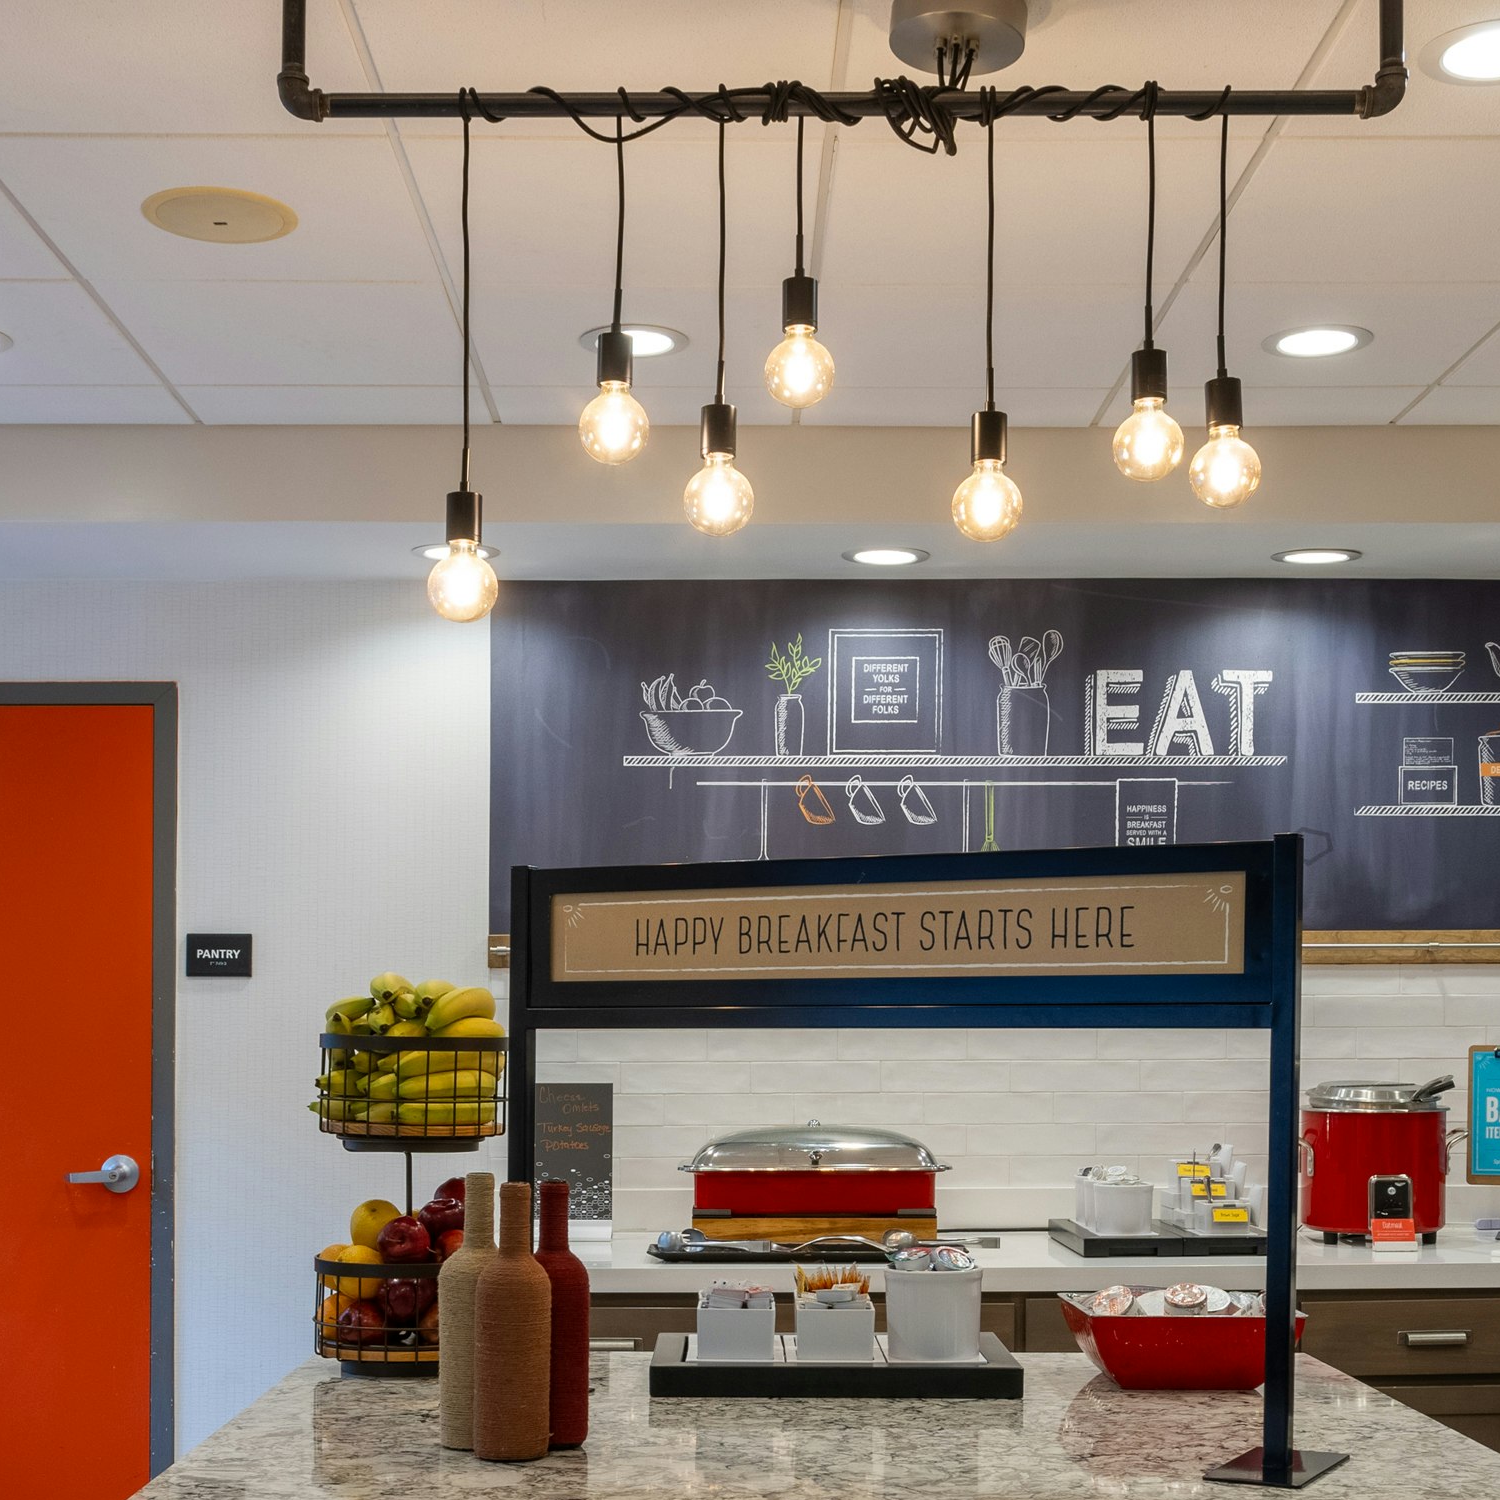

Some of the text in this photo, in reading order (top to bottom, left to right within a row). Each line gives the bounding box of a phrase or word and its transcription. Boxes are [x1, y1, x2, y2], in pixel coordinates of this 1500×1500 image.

[863, 663, 909, 673] DIFFERENT
[872, 674, 900, 683] YOLKS
[863, 694, 908, 704] DIFFERENT
[872, 705, 899, 714] FOLKS
[1086, 669, 1273, 757] EAT
[1407, 780, 1448, 791] RECIPES
[1126, 804, 1167, 813] HAPPINESS
[1126, 820, 1167, 829] BREAKFAST
[635, 906, 1136, 957] HAPPY BREAKFAST STARTS HERE
[196, 949, 241, 959] PANTRY
